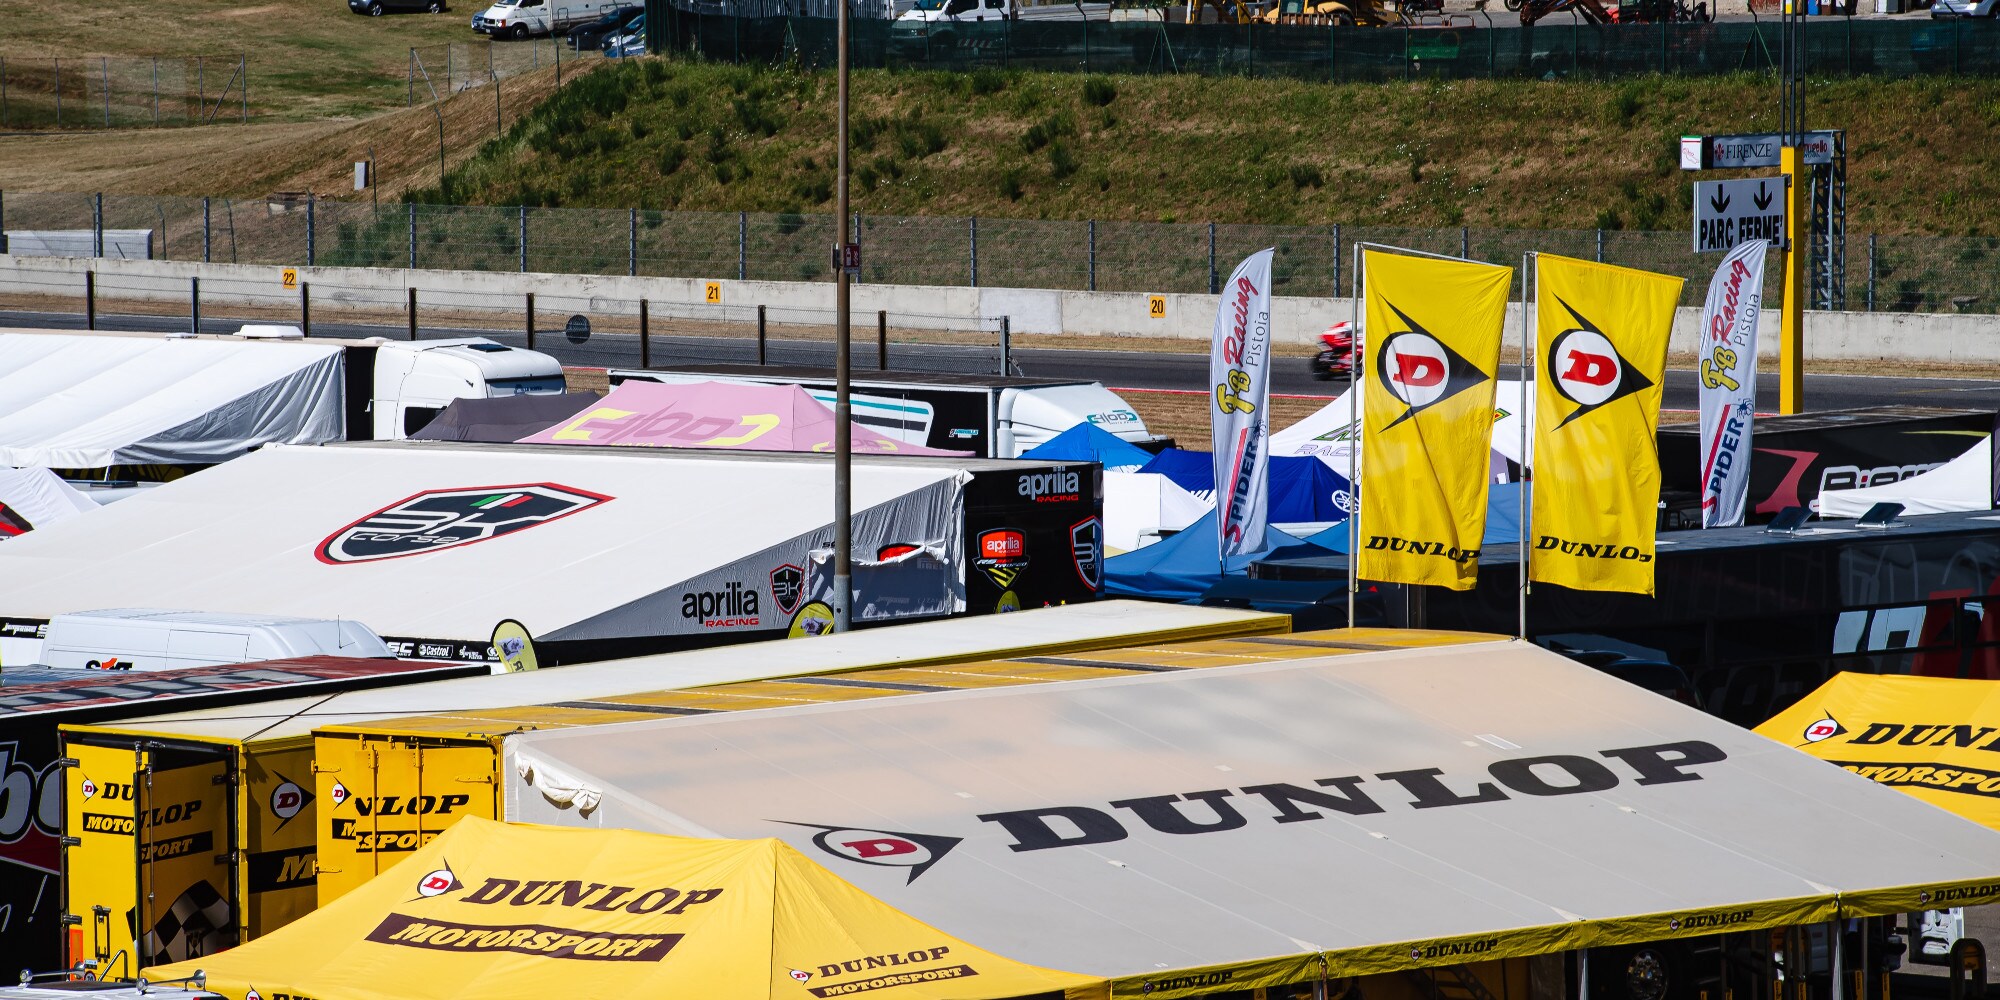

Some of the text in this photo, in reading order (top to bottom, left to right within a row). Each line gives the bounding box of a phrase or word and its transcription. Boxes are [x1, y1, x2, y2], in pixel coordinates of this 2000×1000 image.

[1725, 142, 1773, 162] FIRENZE
[1701, 217, 1734, 249] PARC
[283, 272, 295, 285] 22
[707, 286, 719, 300] 21
[1151, 299, 1164, 314] 20
[1711, 258, 1752, 346] Racing
[1223, 275, 1259, 368] Racing
[1733, 294, 1760, 347] Pistoia
[1246, 311, 1269, 367] Pistoia
[1392, 352, 1446, 387] D
[1561, 349, 1618, 387] D
[1702, 404, 1745, 515] SPIDER
[1018, 466, 1080, 500] aprilia
[1223, 428, 1258, 543] SPIDER
[986, 537, 1020, 553] aprilia
[681, 582, 759, 624] aprilia
[705, 618, 760, 627] RACING
[426, 645, 450, 657] Castrol
[975, 740, 1728, 853] DUNLOP
[458, 877, 724, 916] DUNLOP
[1933, 884, 2000, 903] DUNLOP
[1683, 910, 1754, 929] DUNLOP
[389, 922, 664, 958] MOTORSPORT
[1425, 938, 1498, 959] DUNLOP
[816, 945, 950, 978] DUNLOP
[824, 967, 963, 997] MOTORSPORT
[1158, 970, 1233, 991] DUNLOP
